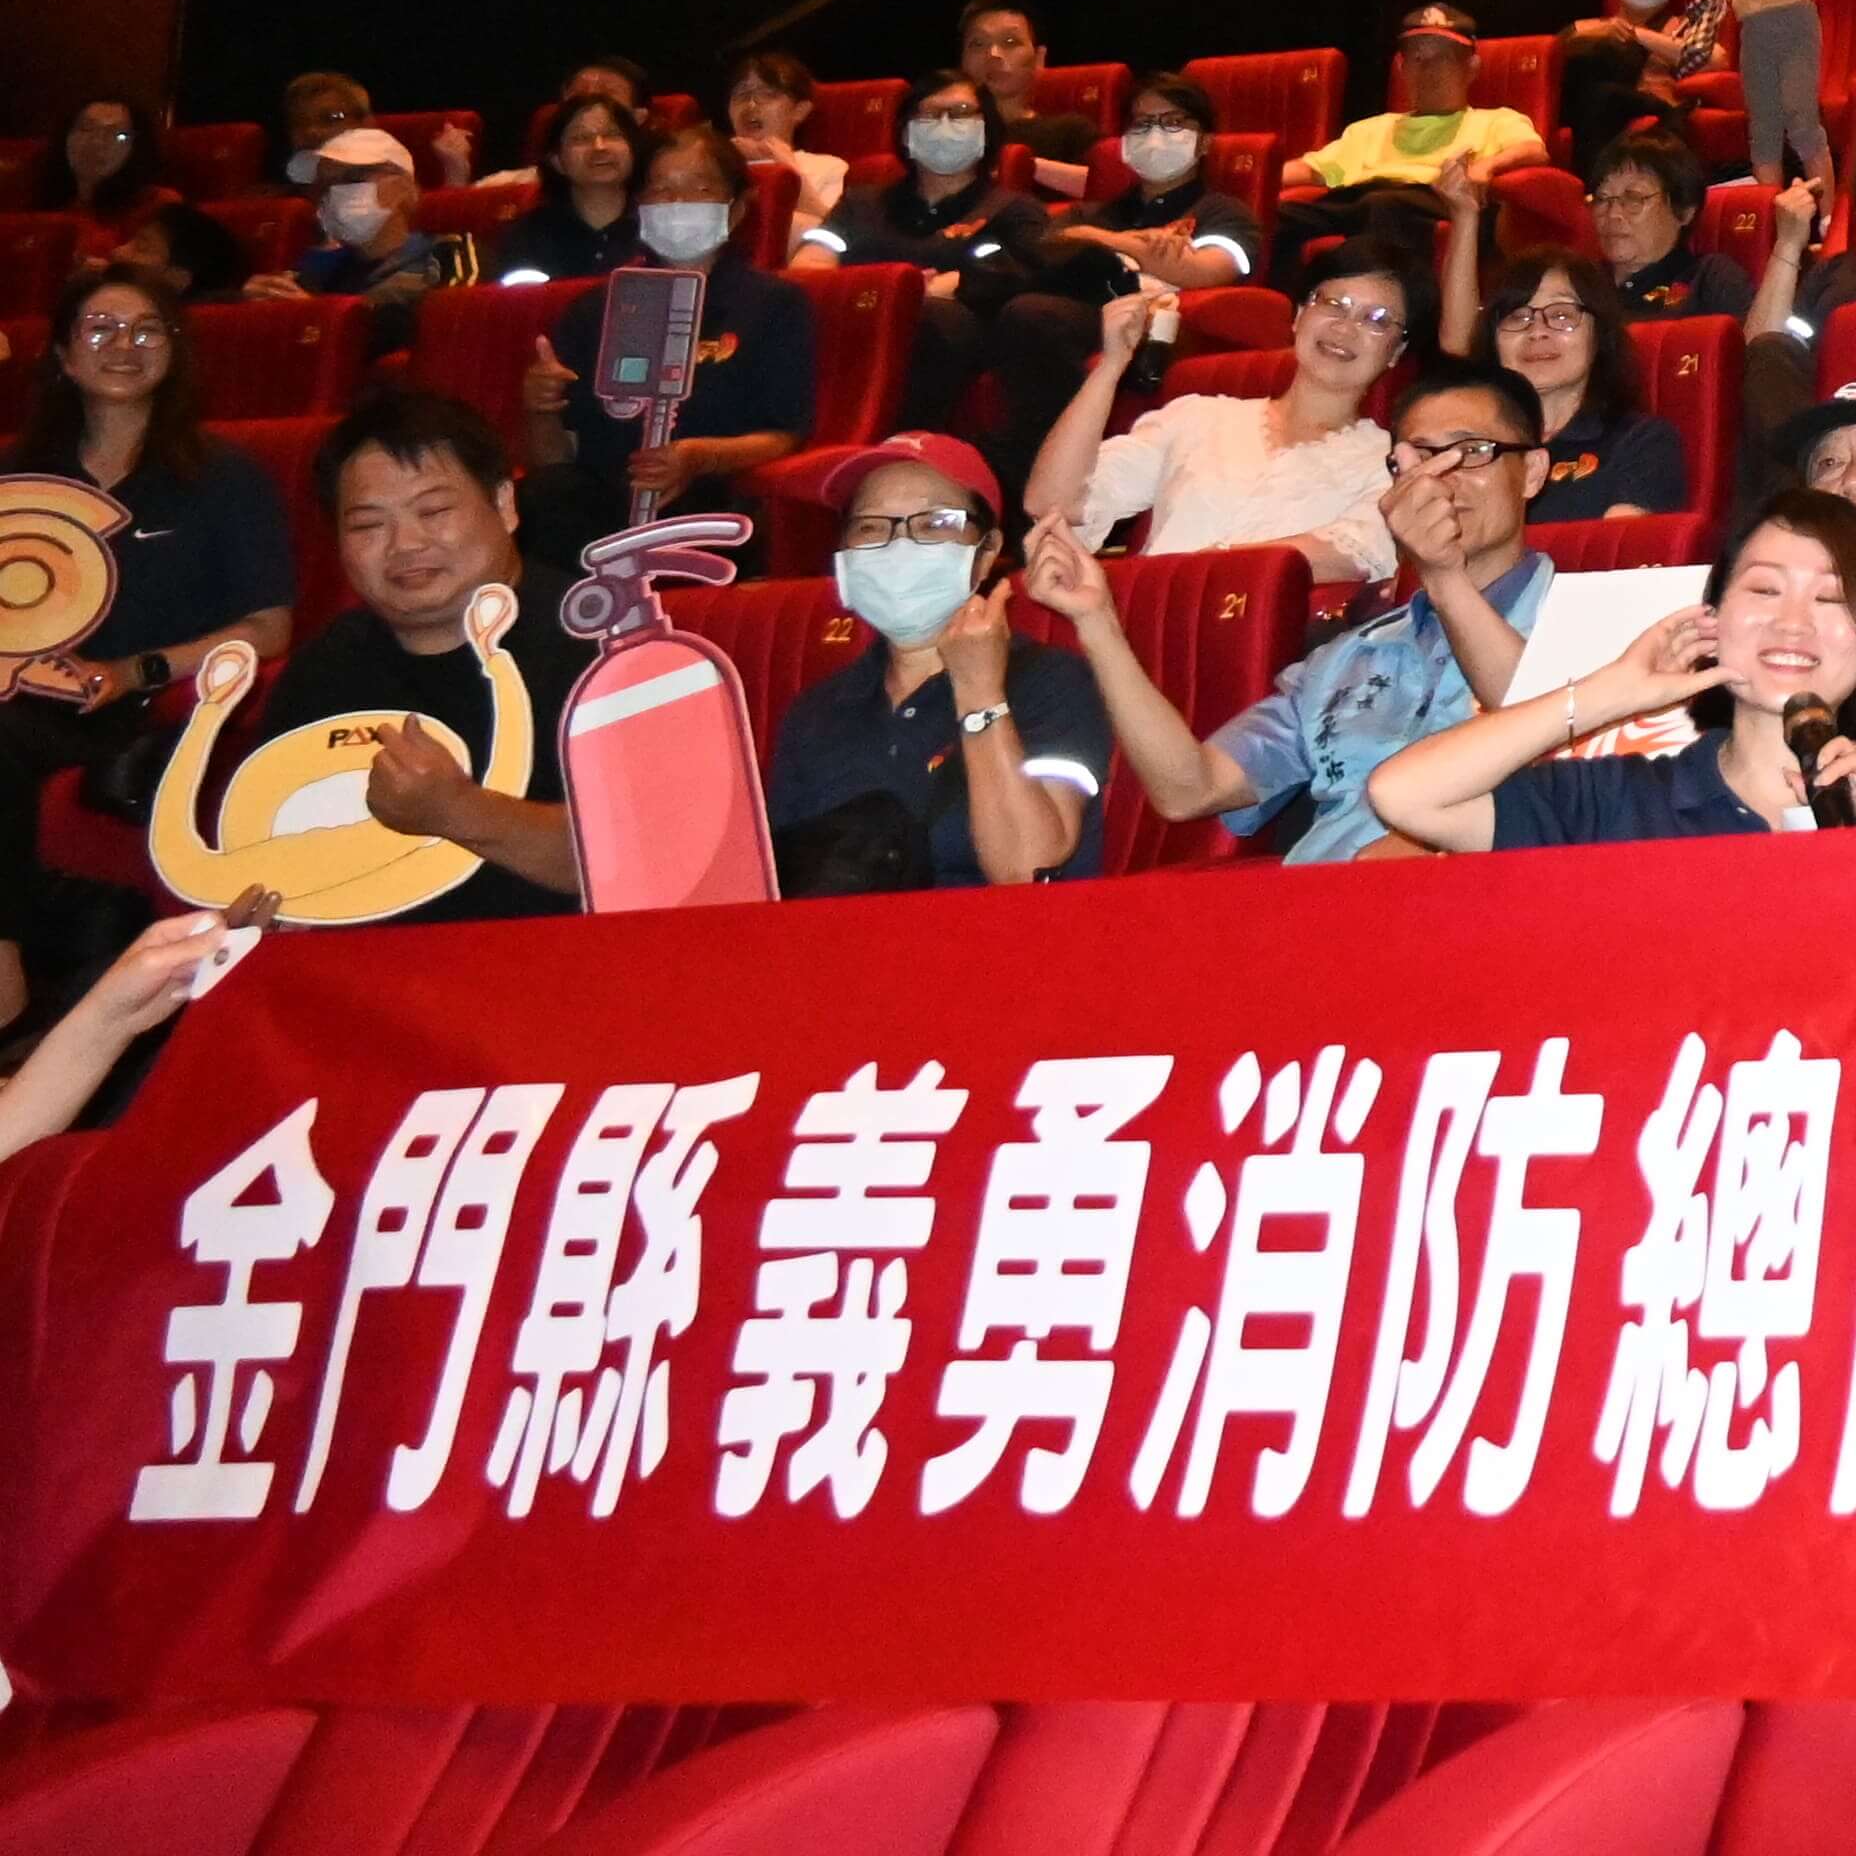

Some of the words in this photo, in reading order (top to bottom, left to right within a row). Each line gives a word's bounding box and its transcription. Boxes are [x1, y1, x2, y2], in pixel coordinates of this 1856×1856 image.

[1733, 211, 1759, 232] 22
[1677, 351, 1703, 376] 21
[1219, 591, 1250, 621] 21
[821, 615, 857, 647] 22
